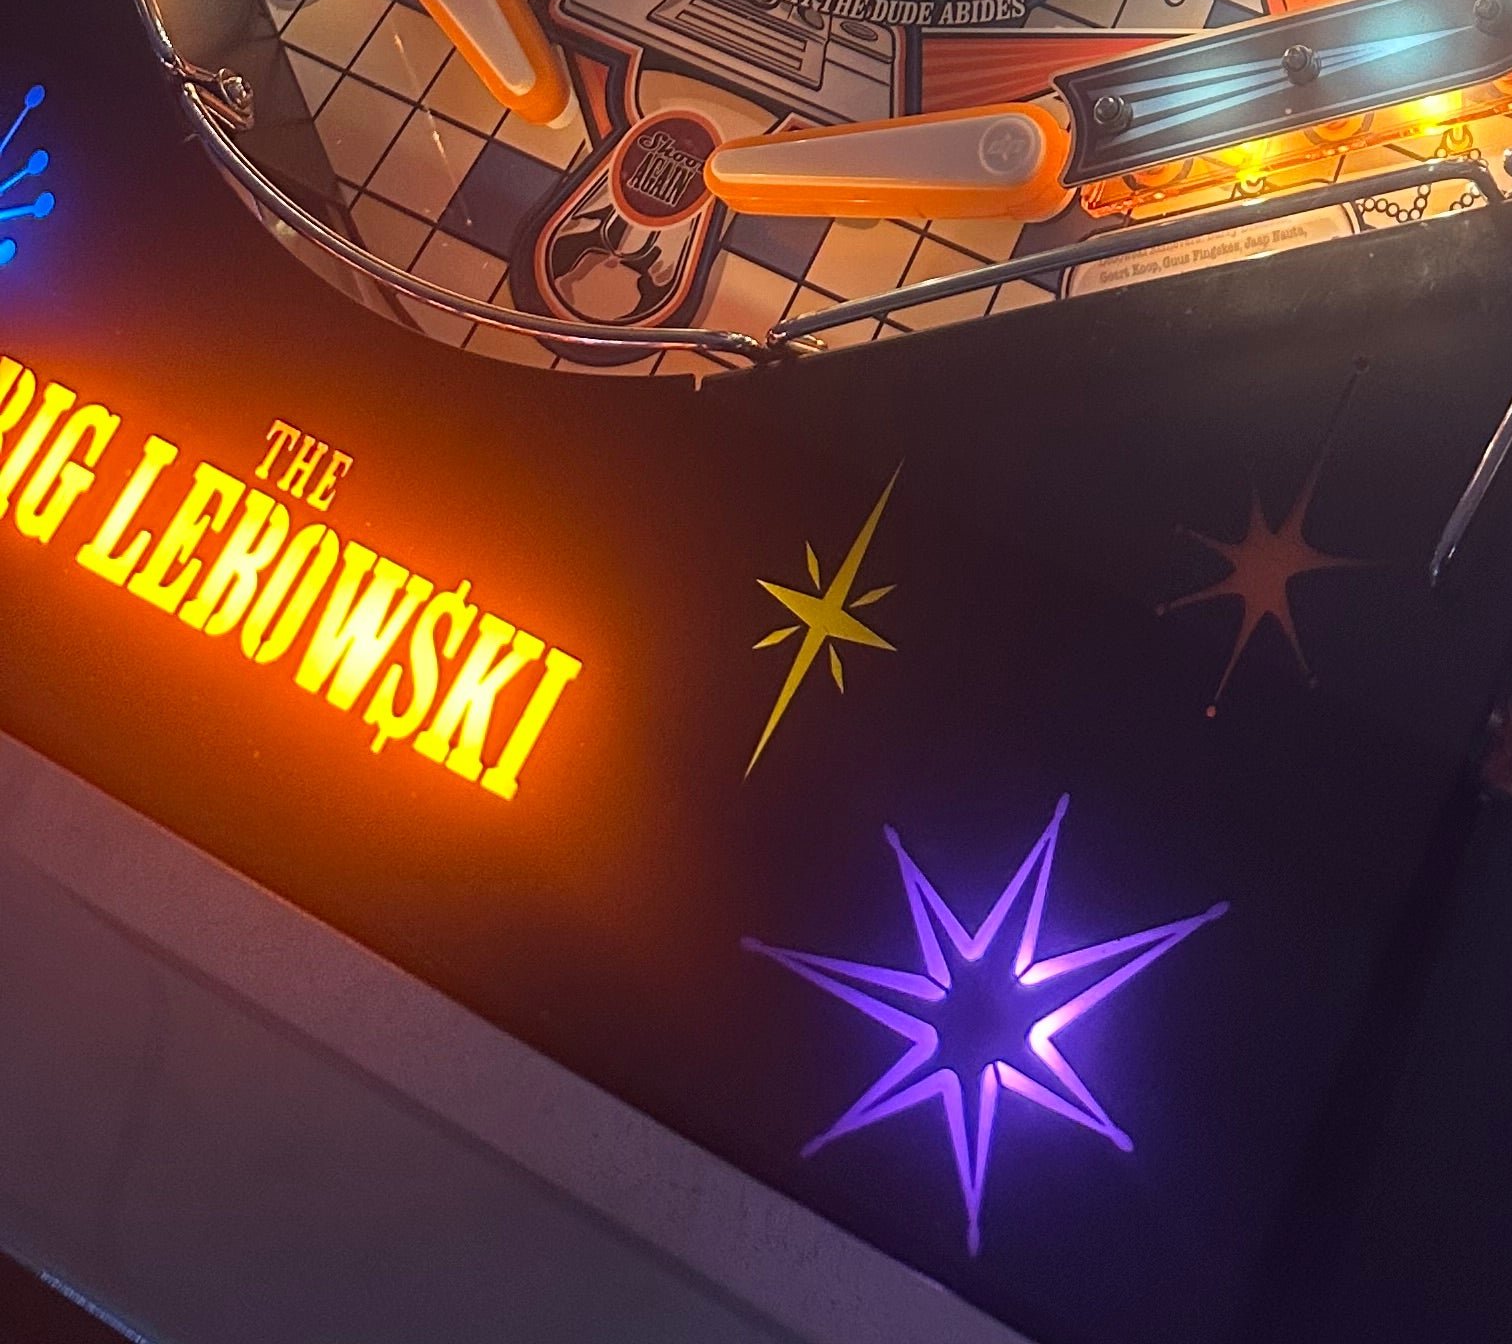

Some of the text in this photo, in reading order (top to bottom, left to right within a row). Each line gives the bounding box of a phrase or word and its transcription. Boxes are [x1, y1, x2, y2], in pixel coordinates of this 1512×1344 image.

[636, 130, 705, 172] Shoo
[627, 152, 698, 207] AGAIN
[253, 417, 354, 512] THE
